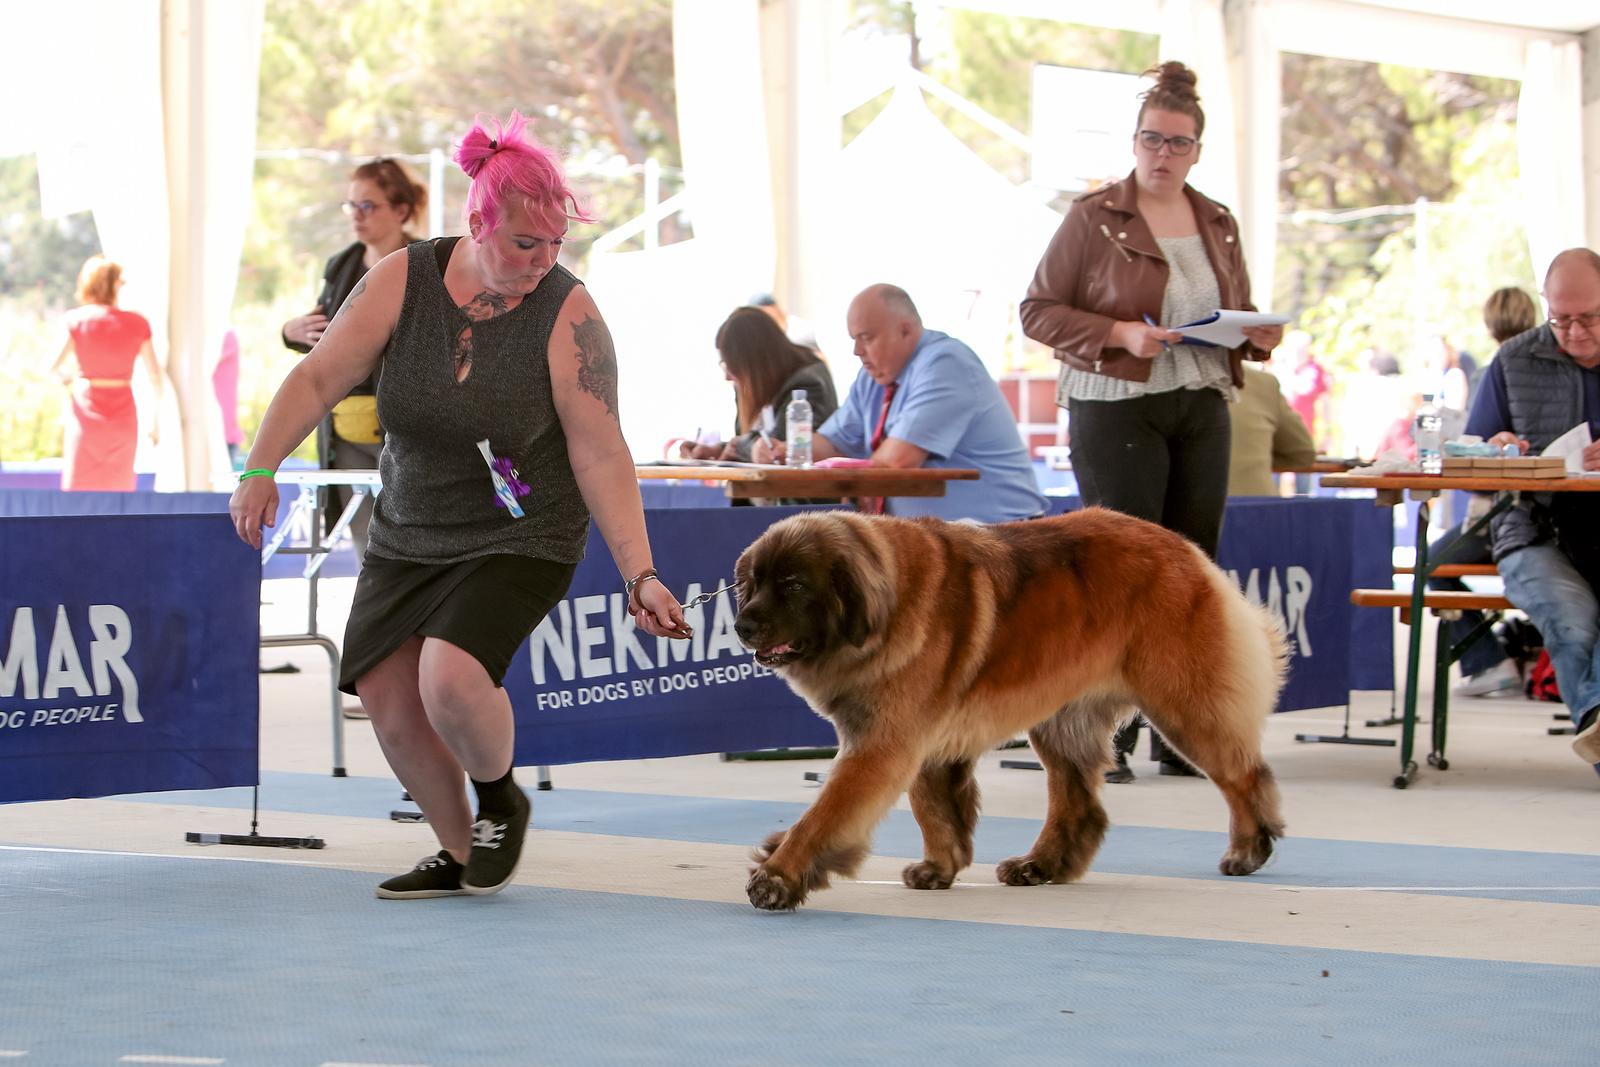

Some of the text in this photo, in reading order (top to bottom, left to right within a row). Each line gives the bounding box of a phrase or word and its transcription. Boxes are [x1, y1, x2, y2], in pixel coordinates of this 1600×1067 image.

[529, 578, 754, 685] NEKMA
[536, 690, 575, 711] FOR
[577, 682, 630, 706] DOGS
[632, 677, 656, 698] BY
[658, 671, 699, 694] DOG
[30, 703, 119, 727] PEOPLE
